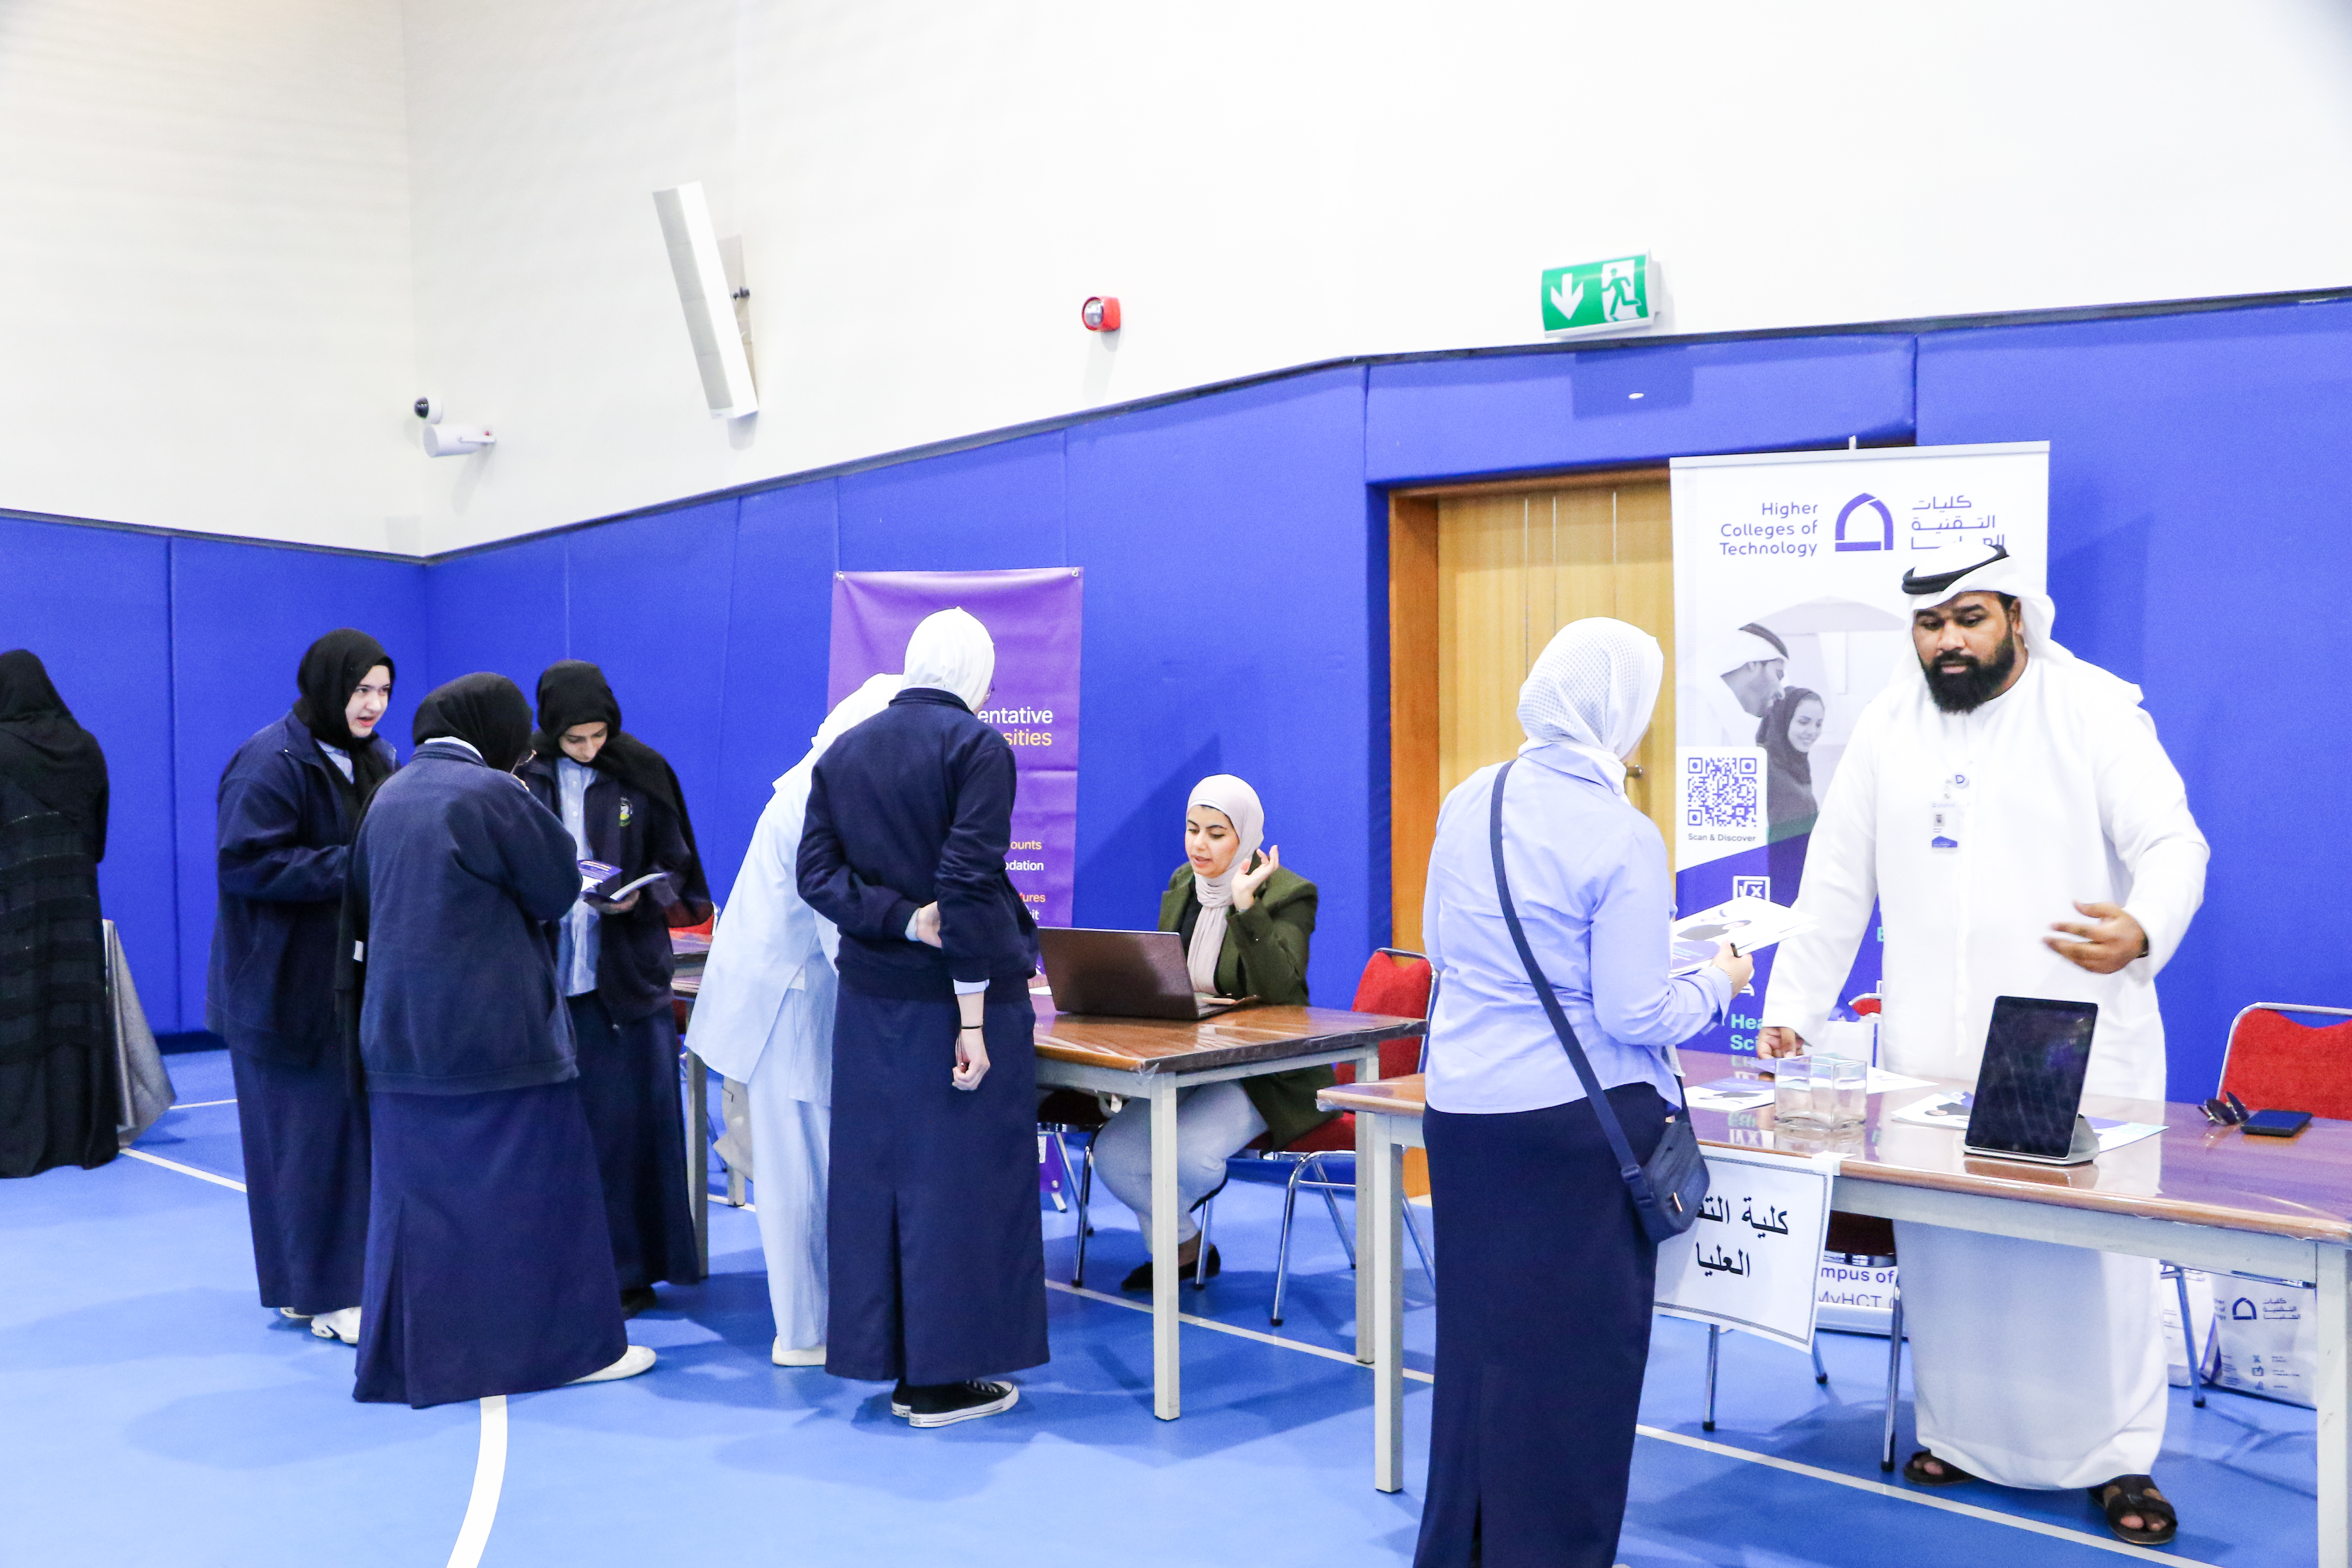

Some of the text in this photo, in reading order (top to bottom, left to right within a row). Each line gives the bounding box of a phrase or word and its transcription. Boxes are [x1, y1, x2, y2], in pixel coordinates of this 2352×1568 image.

[1762, 501, 1818, 519] Higher
[1912, 495, 1972, 513] كليات
[1721, 519, 1818, 539] Colleges of
[1911, 514, 1996, 534] التقنية
[1719, 541, 1818, 557] Technology
[977, 706, 1053, 724] entative
[1003, 728, 1053, 746] sities
[1010, 840, 1042, 850] ounts
[1688, 833, 1707, 841] Scan
[1742, 1196, 1788, 1239] كلية
[1696, 1241, 1750, 1278] العليا
[1821, 1267, 1895, 1283] mpus of
